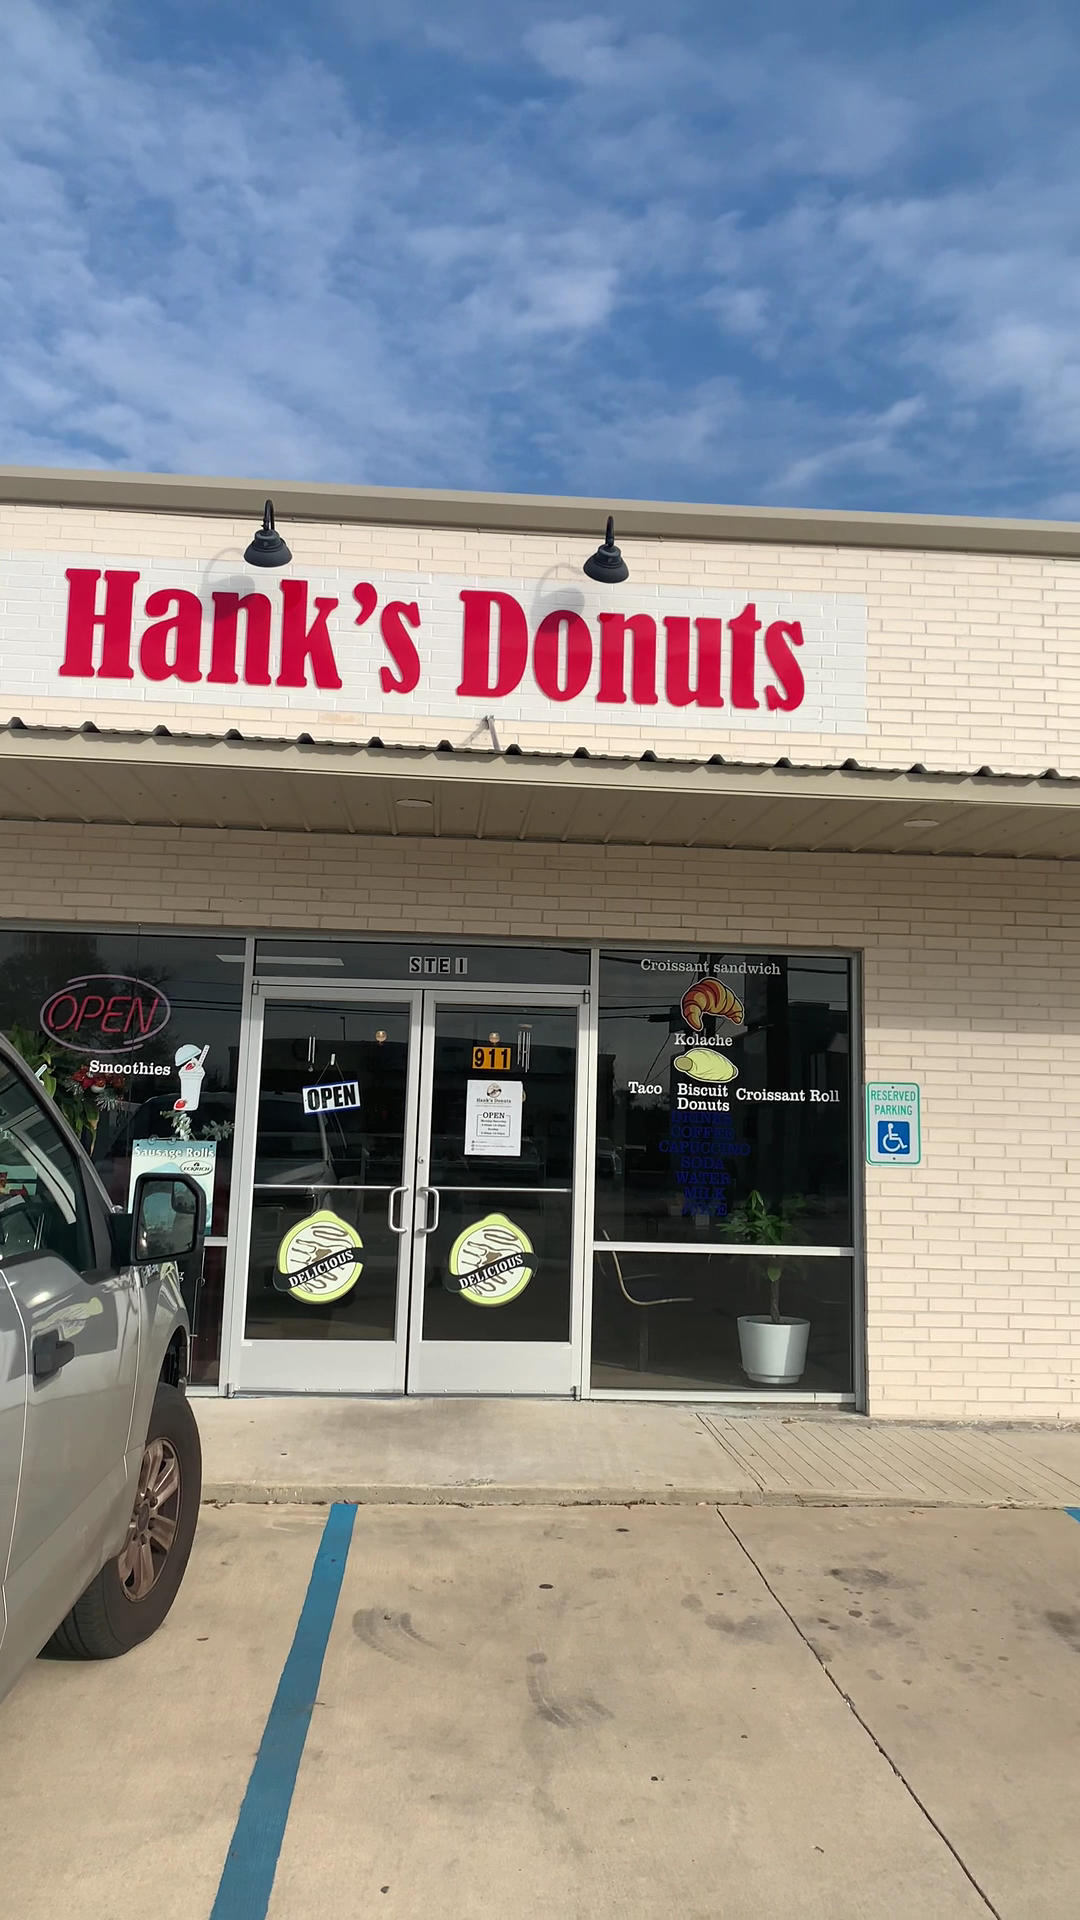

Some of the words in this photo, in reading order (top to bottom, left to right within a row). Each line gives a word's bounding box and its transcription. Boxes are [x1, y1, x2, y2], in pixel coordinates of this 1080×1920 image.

[58, 568, 421, 694] Hank's
[457, 589, 805, 711] Donuts
[410, 957, 450, 973] STE
[640, 957, 709, 973] Croissant
[713, 961, 781, 975] sandwich
[47, 994, 161, 1033] OPEN
[674, 1033, 733, 1047] Kolache
[474, 1048, 511, 1068] 911
[89, 1060, 171, 1076] Smoothies
[628, 1081, 663, 1095] Taco
[677, 1083, 728, 1097] Biscuit
[307, 1084, 356, 1110] OPEN
[735, 1088, 806, 1102] Croissant
[809, 1089, 840, 1103] Roll
[870, 1089, 916, 1103] RESERVED
[677, 1097, 730, 1111] Donuts
[874, 1104, 913, 1116] PARKING
[482, 1111, 505, 1119] OPEN
[672, 1112, 731, 1124] DRINKS
[671, 1126, 735, 1139] COFFEE
[134, 1146, 182, 1159] Sausage
[186, 1147, 215, 1158] Rolls
[681, 1156, 725, 1169] SODA
[676, 1172, 731, 1185] WATER
[683, 1187, 725, 1200] MILK
[288, 1249, 354, 1287] DELICIOUS
[458, 1254, 523, 1289] DELICIOUS
